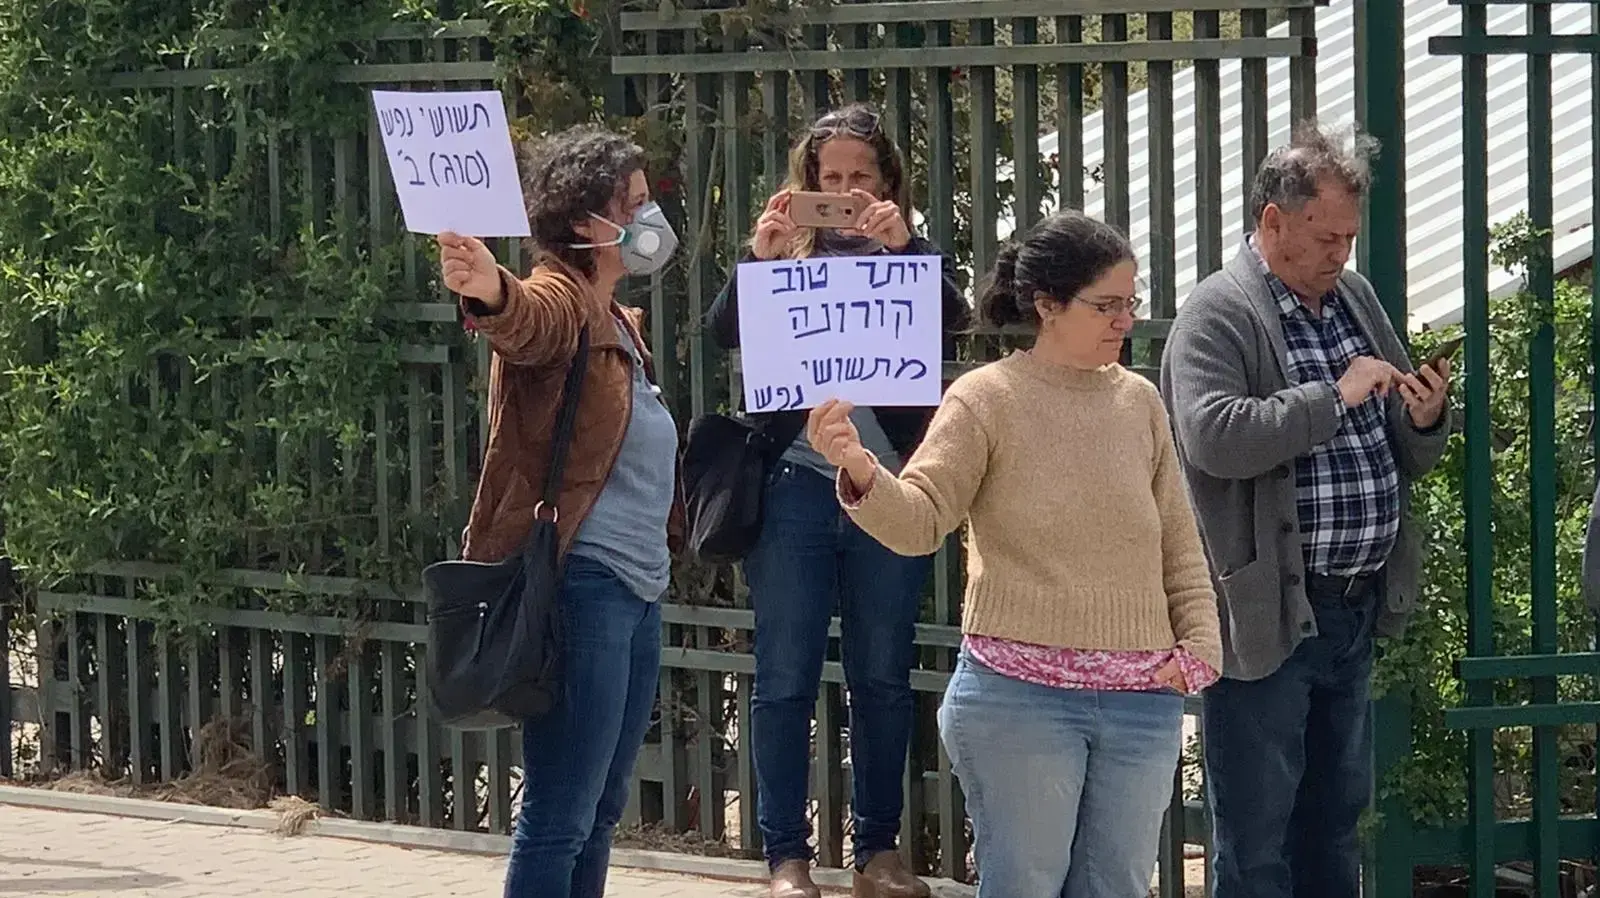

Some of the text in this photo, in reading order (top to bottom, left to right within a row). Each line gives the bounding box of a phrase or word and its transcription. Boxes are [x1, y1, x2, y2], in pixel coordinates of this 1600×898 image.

[380, 103, 490, 138] תשושי נפש
[429, 150, 490, 189] (סוג)
[856, 261, 928, 289] יותר
[788, 299, 912, 339] קורונה
[801, 357, 927, 385] מתשושי
[755, 385, 804, 411] נפש
